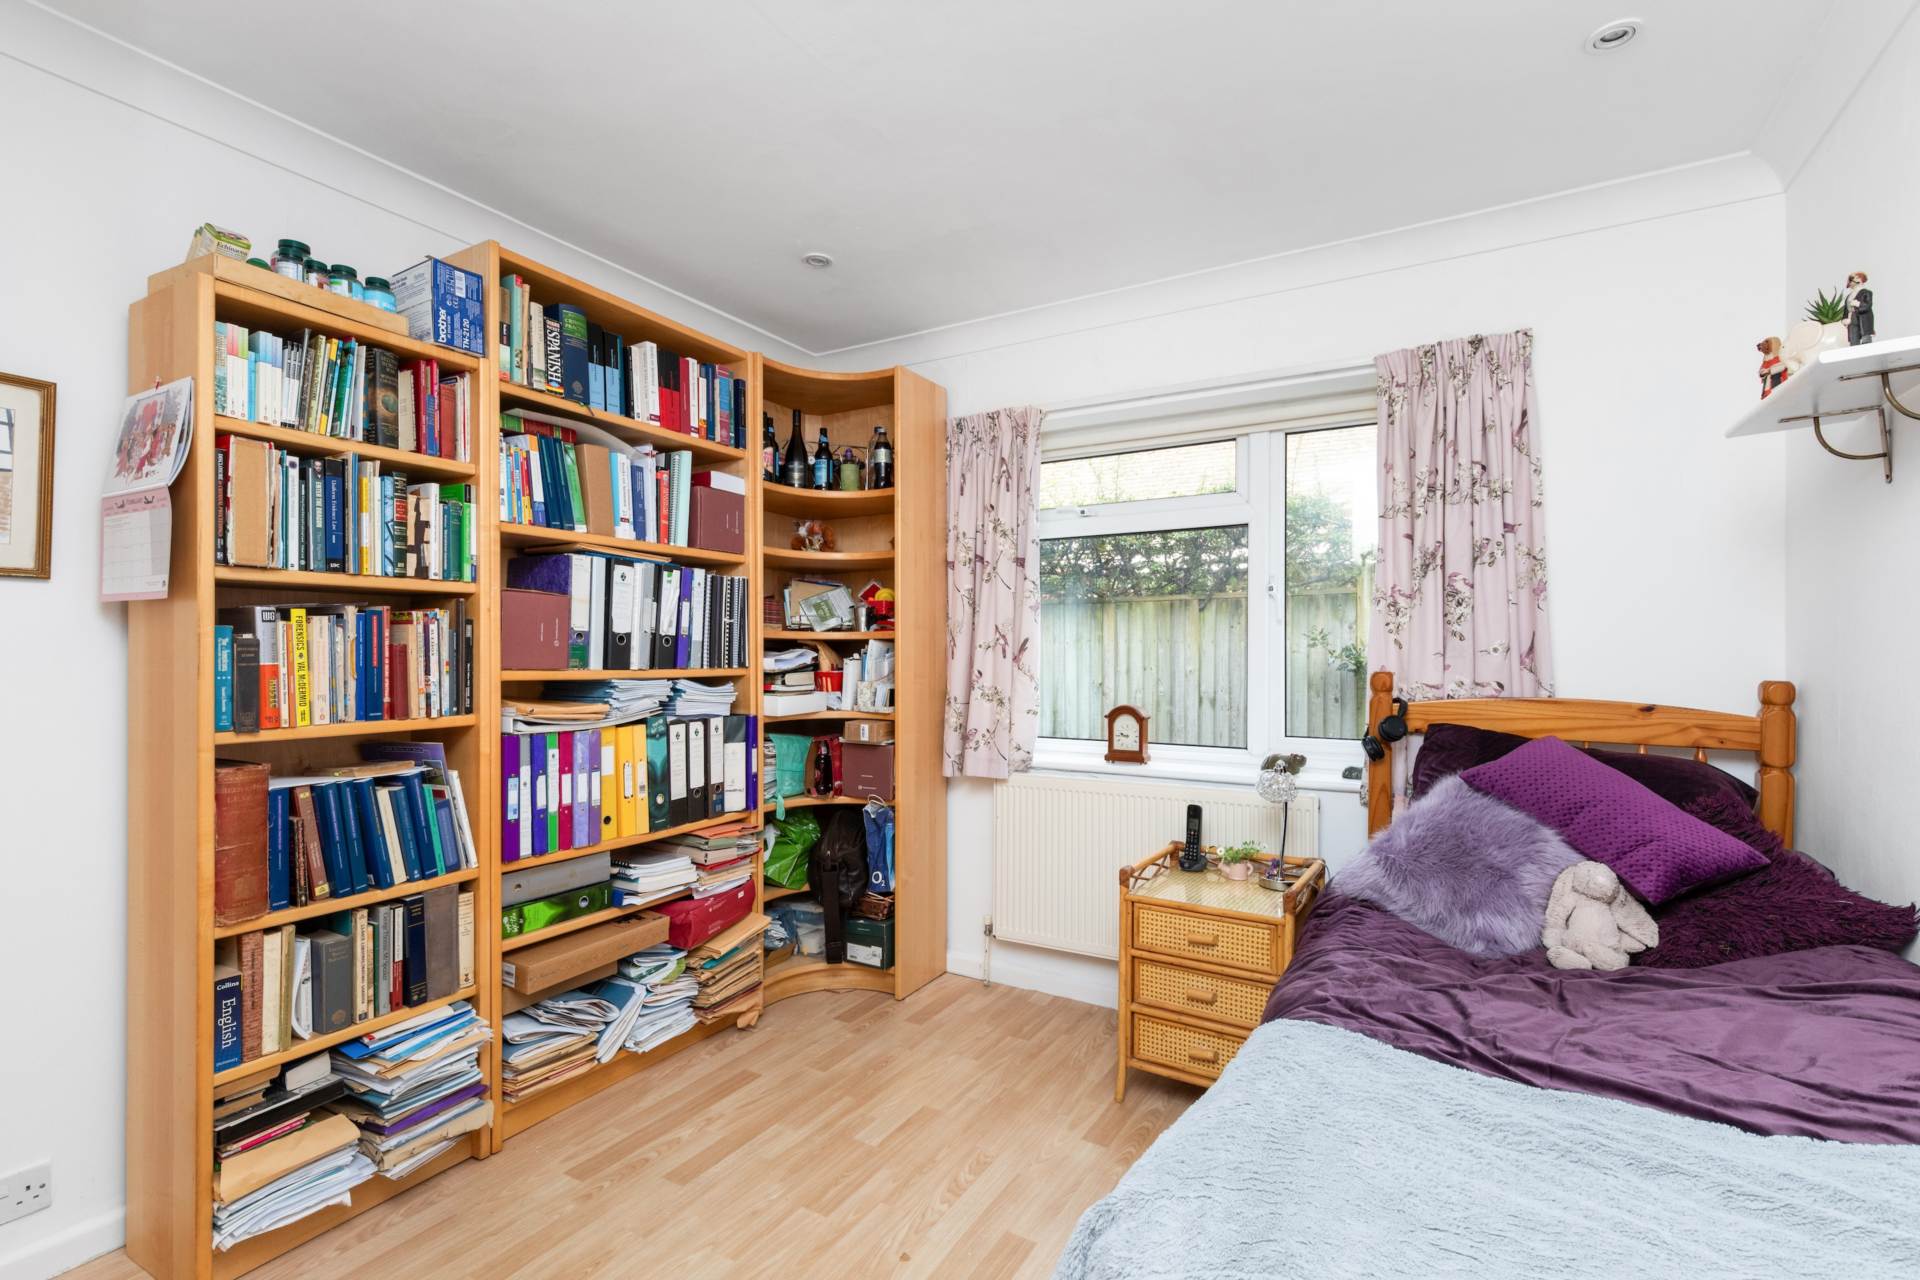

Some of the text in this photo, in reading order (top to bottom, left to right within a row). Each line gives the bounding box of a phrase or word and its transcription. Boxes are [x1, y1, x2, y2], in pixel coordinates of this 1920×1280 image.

[437, 306, 447, 343] brother
[462, 319, 470, 349] TN-2120
[547, 329, 561, 382] SPANISH
[296, 615, 305, 651] FORENSICS
[297, 661, 306, 673] VAL
[872, 871, 886, 887] O2
[216, 981, 239, 991] Collins
[217, 997, 236, 1049] English
